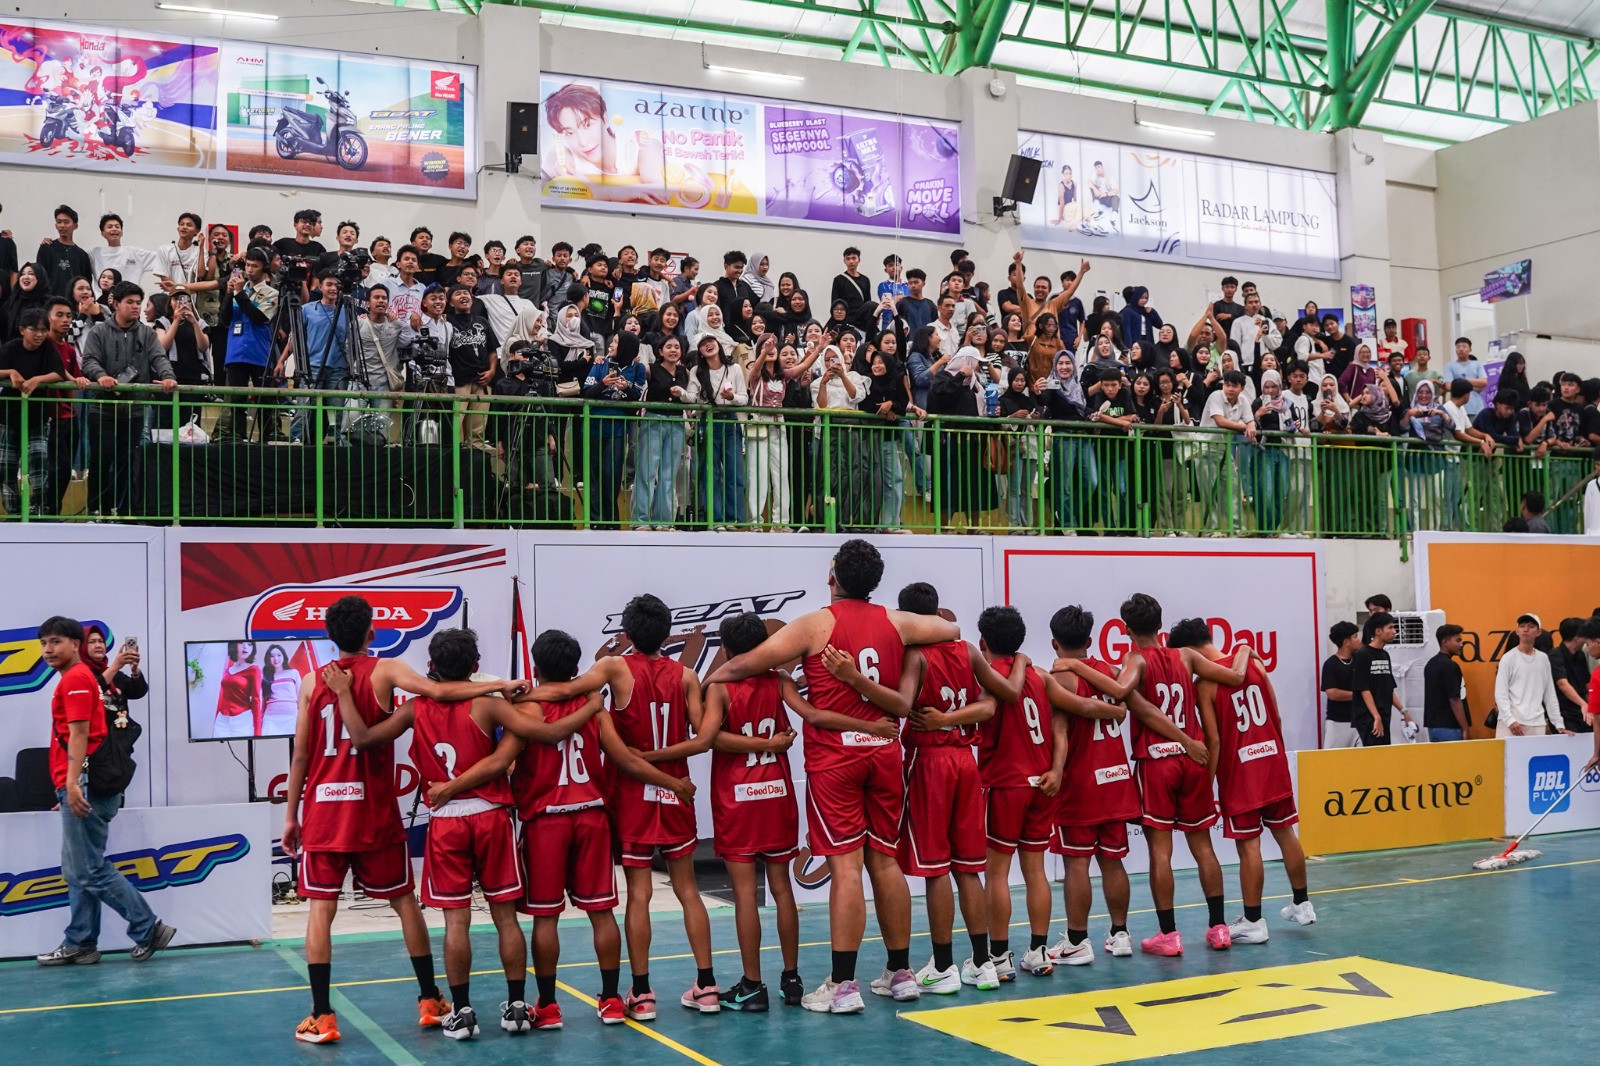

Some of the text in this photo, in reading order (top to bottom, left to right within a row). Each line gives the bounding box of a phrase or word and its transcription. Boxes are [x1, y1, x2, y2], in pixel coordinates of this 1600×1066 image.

[769, 118, 826, 129] BLUEBERRY BLAST
[384, 130, 443, 141] BENER
[662, 129, 744, 147] No Panik
[771, 128, 829, 143] SEGERNYA
[773, 140, 832, 154] NAMPOOOL
[907, 187, 953, 204] MOVE
[1128, 213, 1168, 228] Jackson
[1201, 199, 1320, 230] RADAR LAMPUNG
[305, 606, 412, 620] HDA
[602, 590, 806, 634] eAT
[857, 647, 880, 702] 6
[1155, 683, 1186, 729] 22
[1231, 684, 1268, 733] 50
[1023, 697, 1045, 745] 9
[741, 717, 777, 767] 12
[557, 732, 590, 786] 16
[1533, 770, 1565, 792] DBL
[324, 786, 348, 797] Good
[746, 784, 785, 797] Good Day
